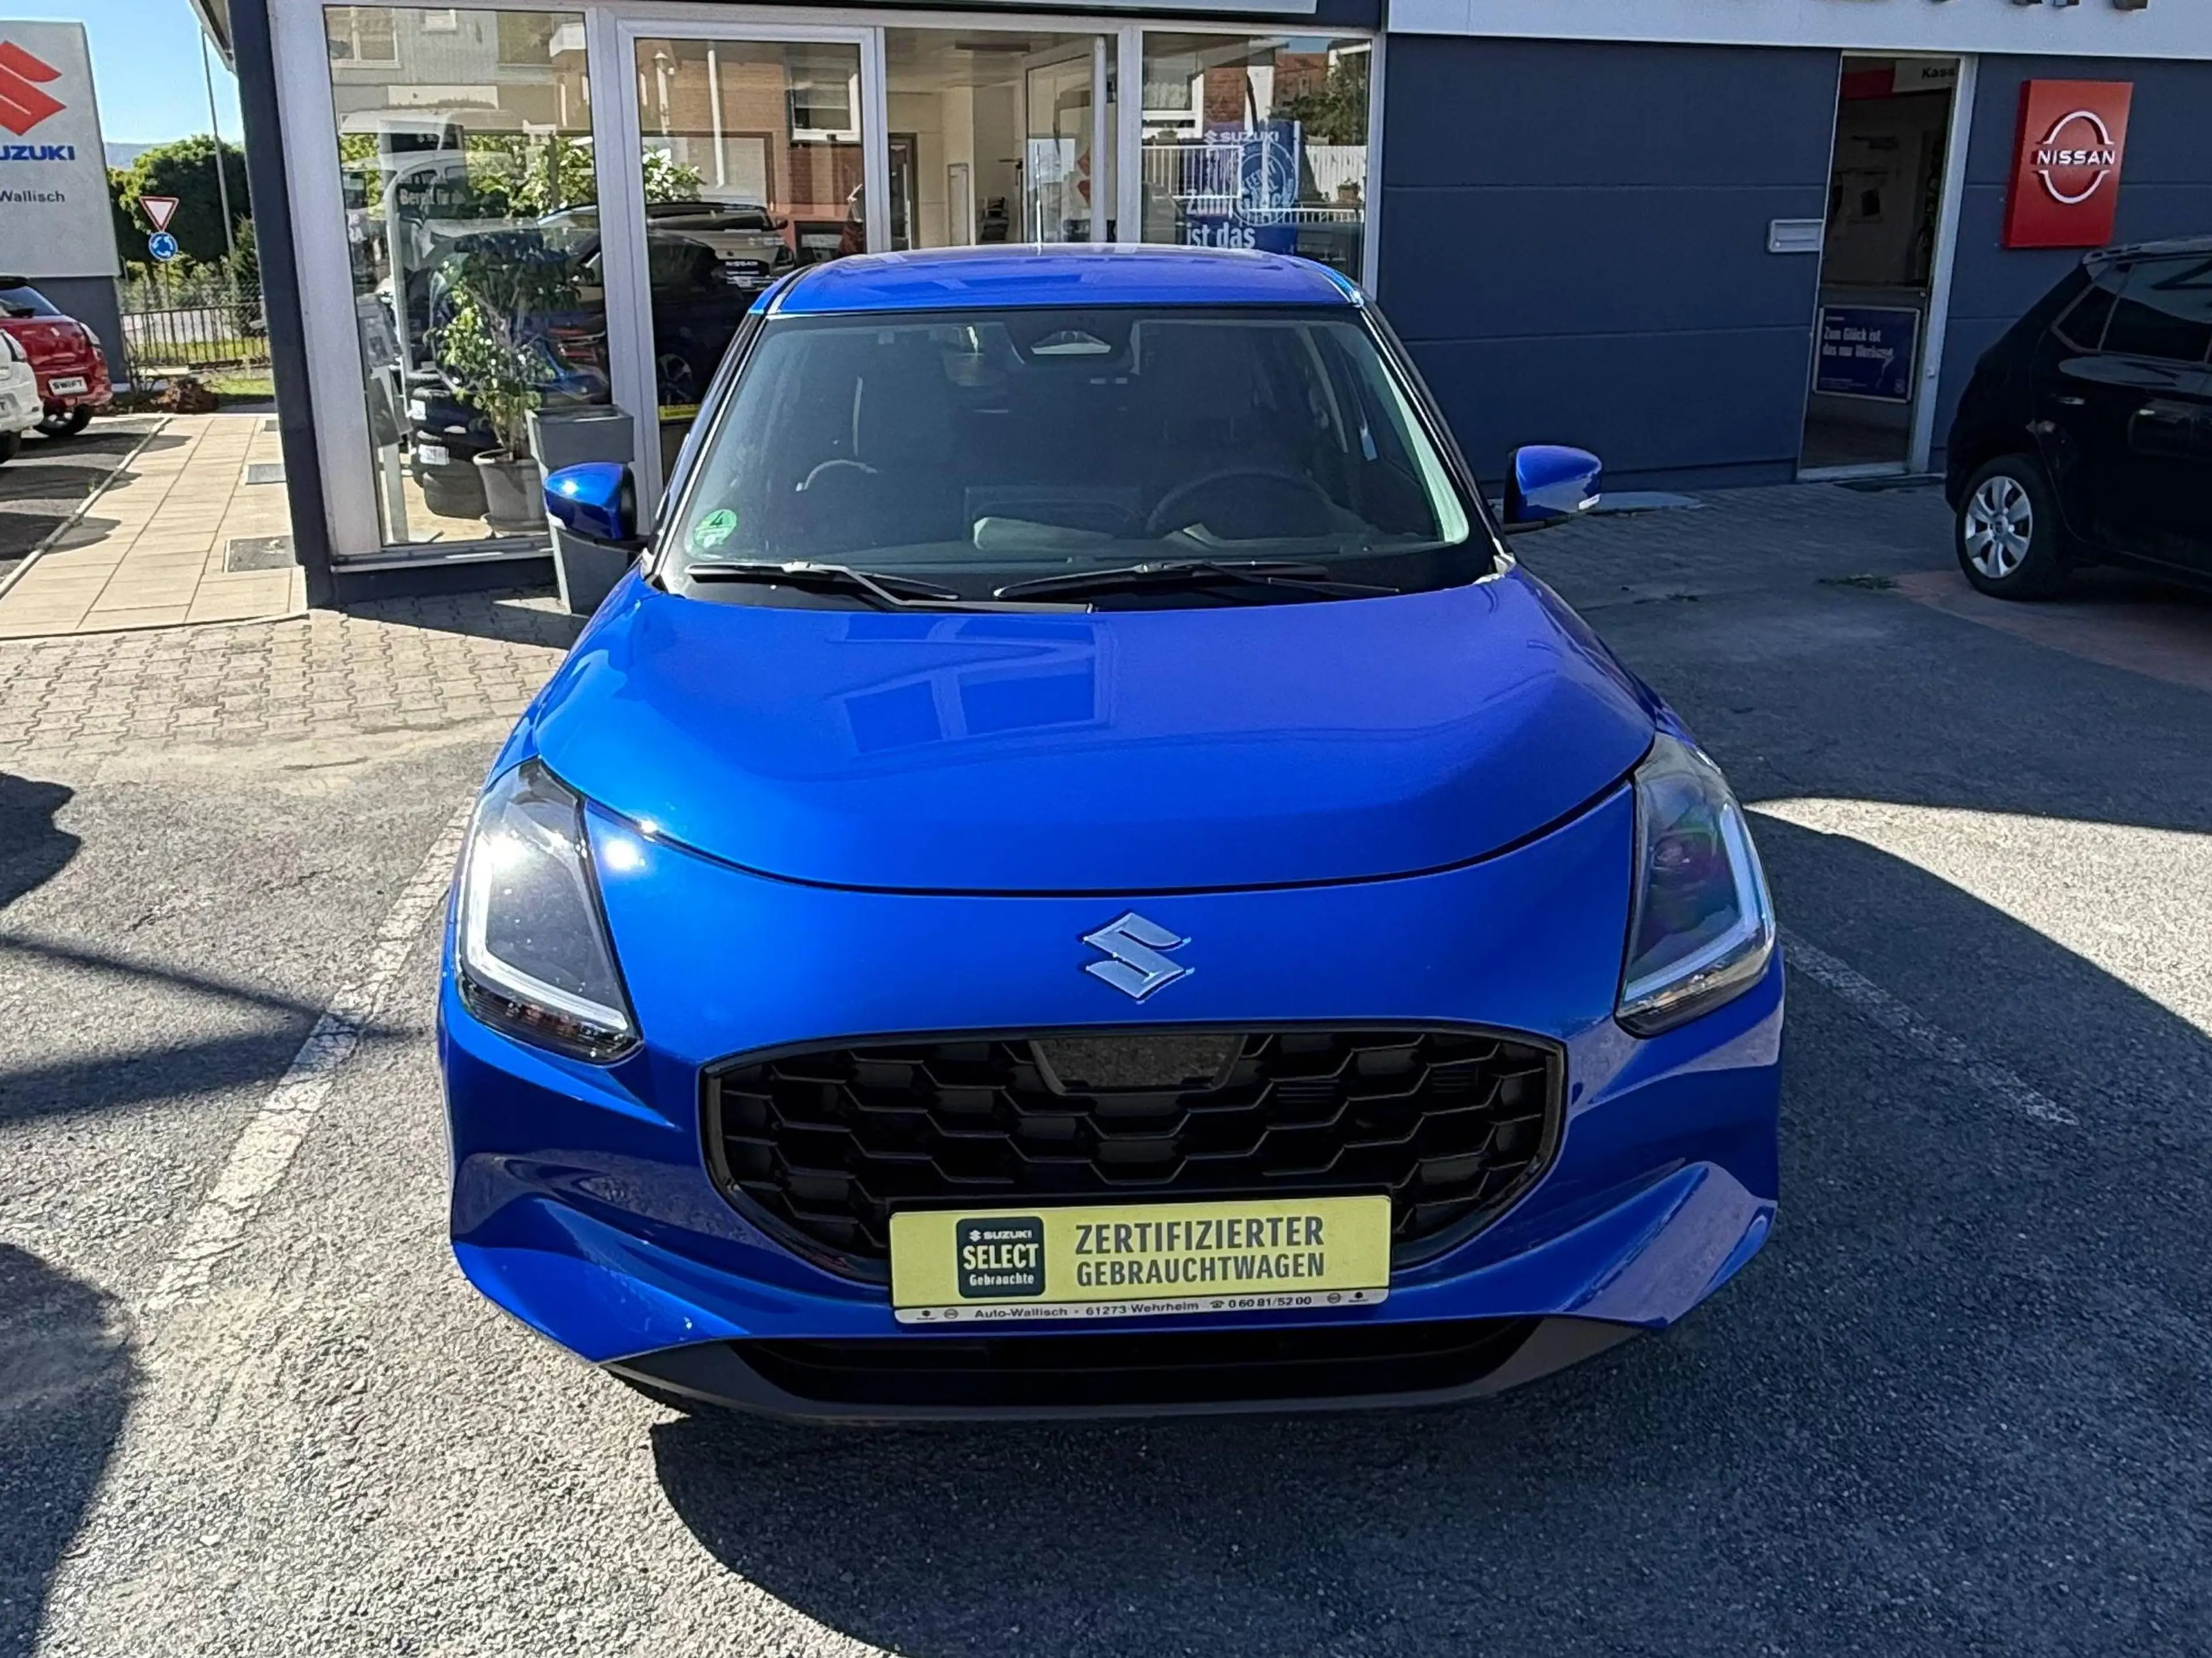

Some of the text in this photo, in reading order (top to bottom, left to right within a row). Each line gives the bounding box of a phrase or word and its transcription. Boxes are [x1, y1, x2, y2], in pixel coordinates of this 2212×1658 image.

[2037, 150, 2115, 165] NISSAN
[0, 190, 65, 202] Wallisch
[1186, 221, 1256, 249] ist das
[52, 379, 84, 390] SWIFT
[983, 1230, 1032, 1240] SUZUKI
[1075, 1216, 1324, 1255] ZERTIFIZIERTER
[963, 1243, 1039, 1270] SELECT
[1077, 1252, 1324, 1287] GEBRAUCHTWAGEN
[969, 1272, 1035, 1287] Gebrauchte
[974, 1307, 1068, 1319] Auto-Wallisch
[1085, 1305, 1127, 1316] 61273
[1130, 1302, 1200, 1314] Wehrheim
